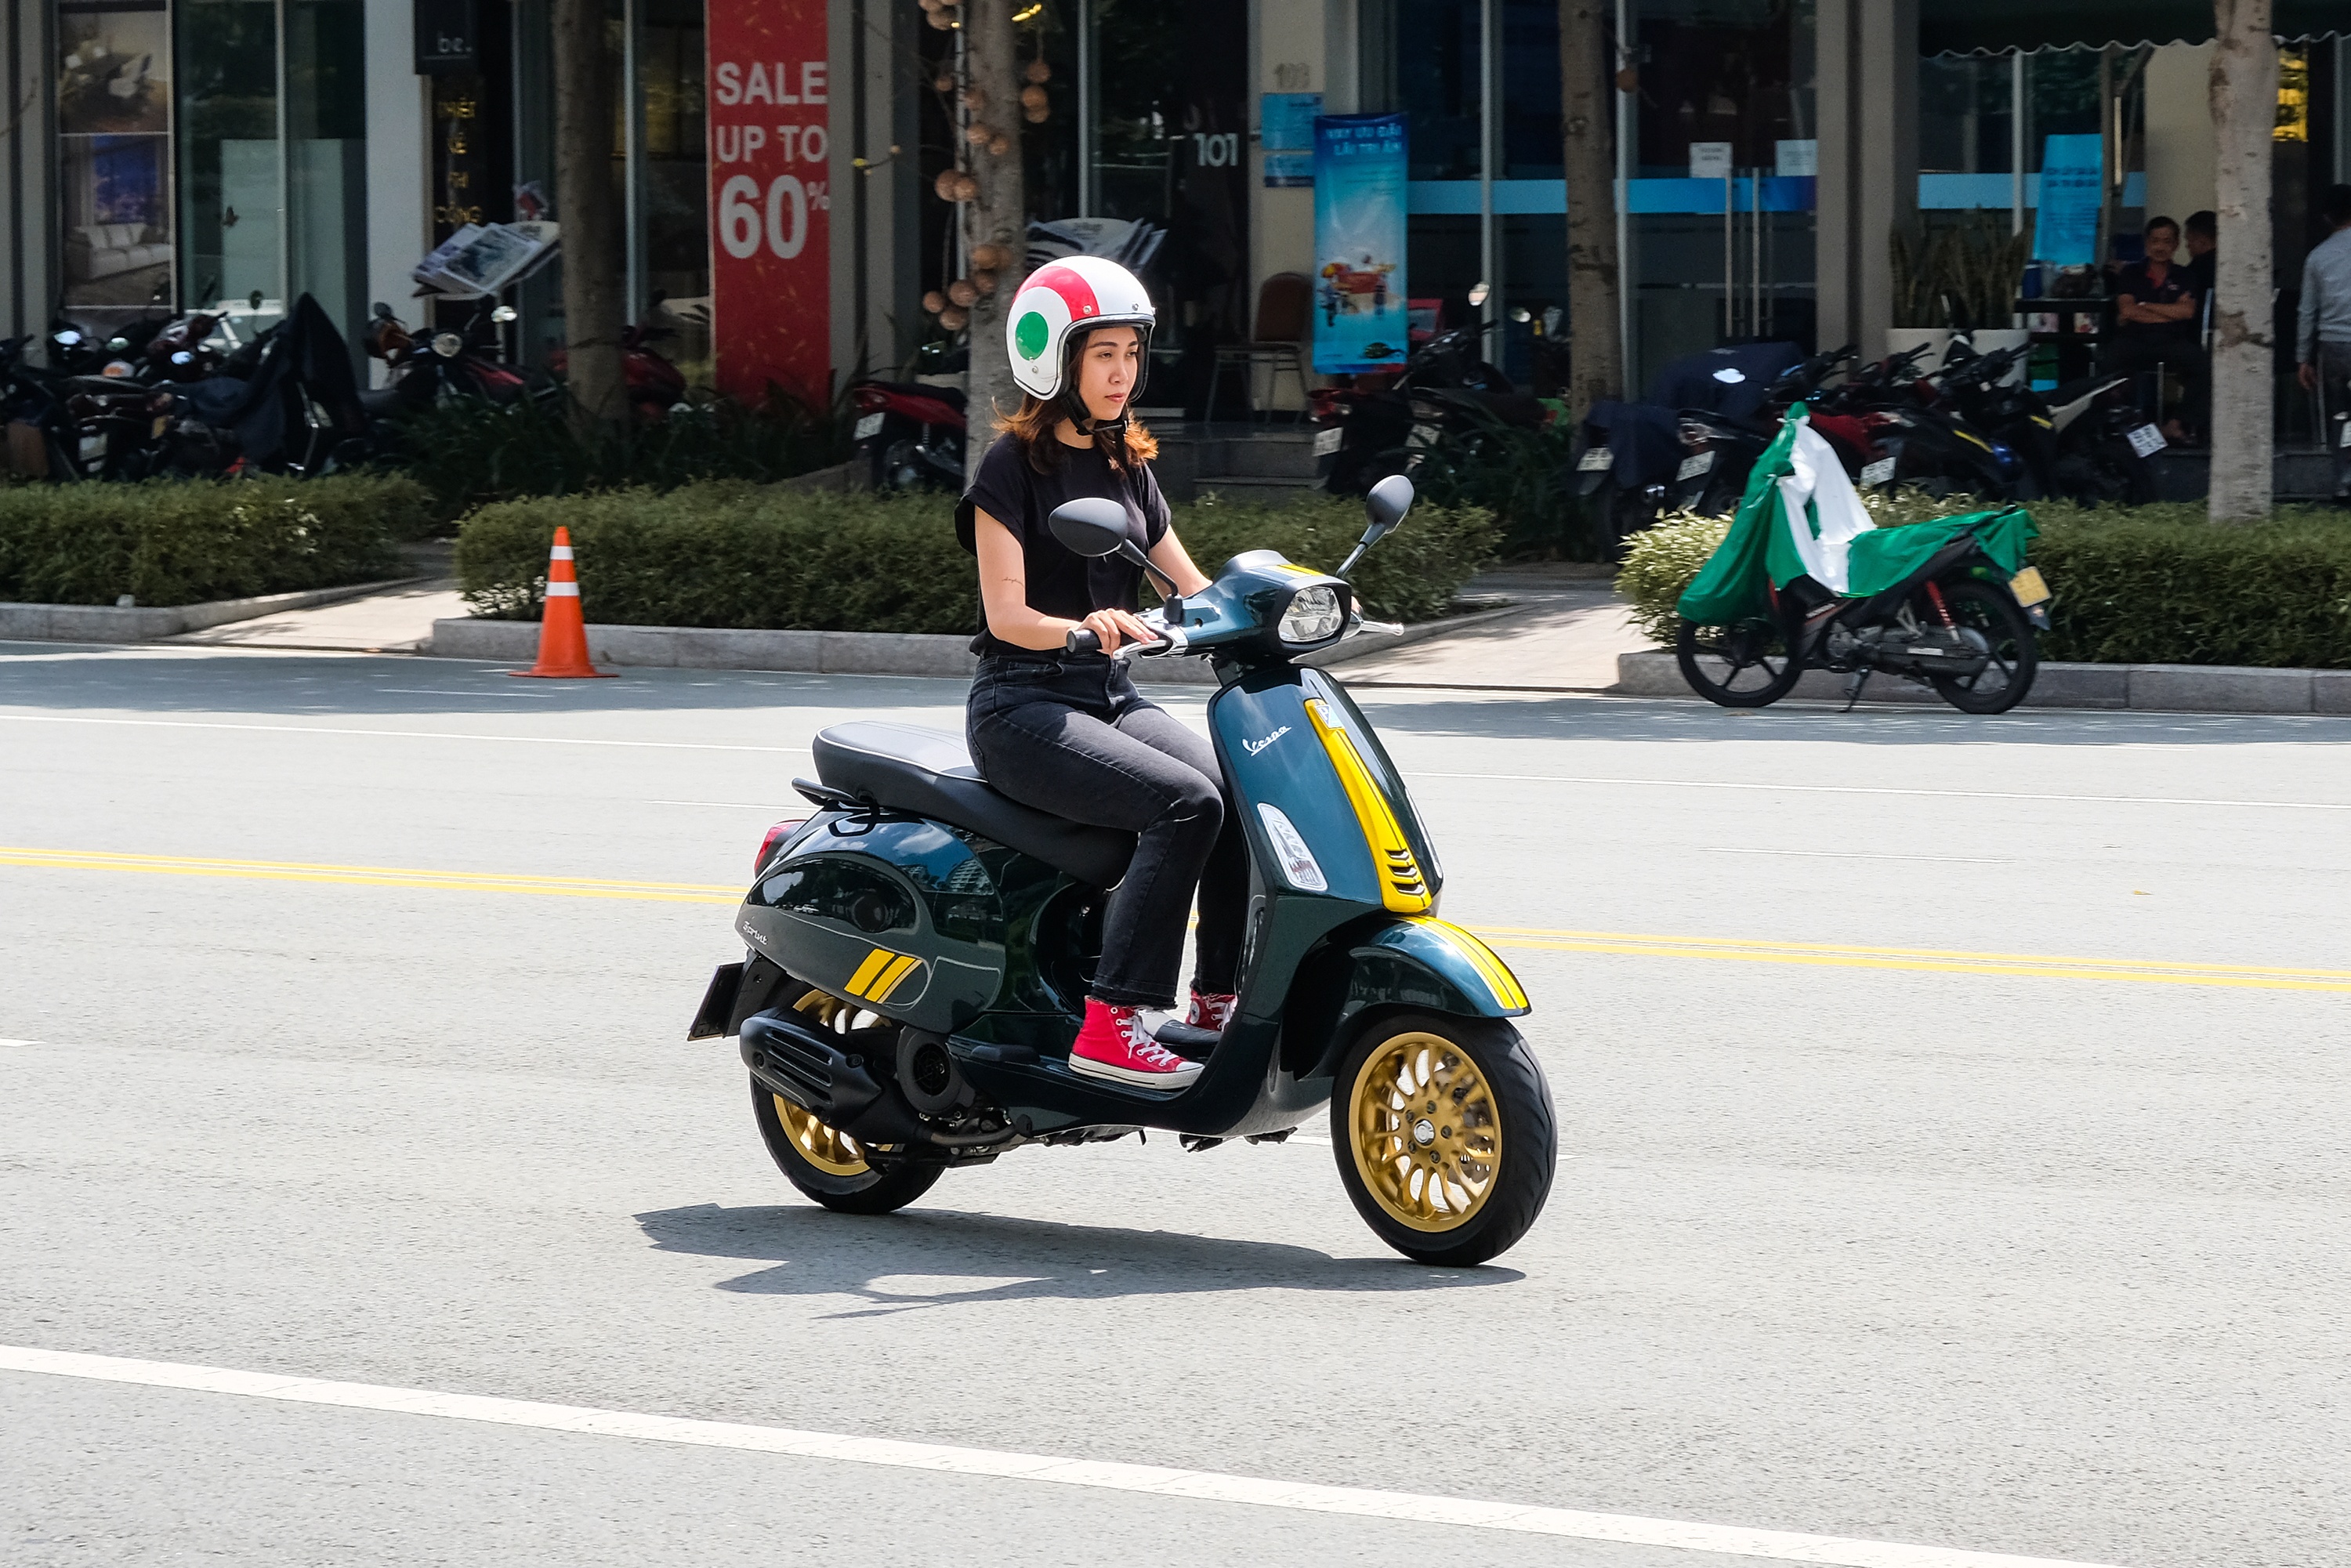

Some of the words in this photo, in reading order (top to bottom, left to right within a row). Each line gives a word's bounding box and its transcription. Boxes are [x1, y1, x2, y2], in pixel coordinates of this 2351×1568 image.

[715, 61, 828, 106] SALE
[716, 125, 766, 163] UP
[777, 125, 828, 163] TO
[1193, 132, 1238, 167] 101
[1242, 726, 1292, 757] Vespa
